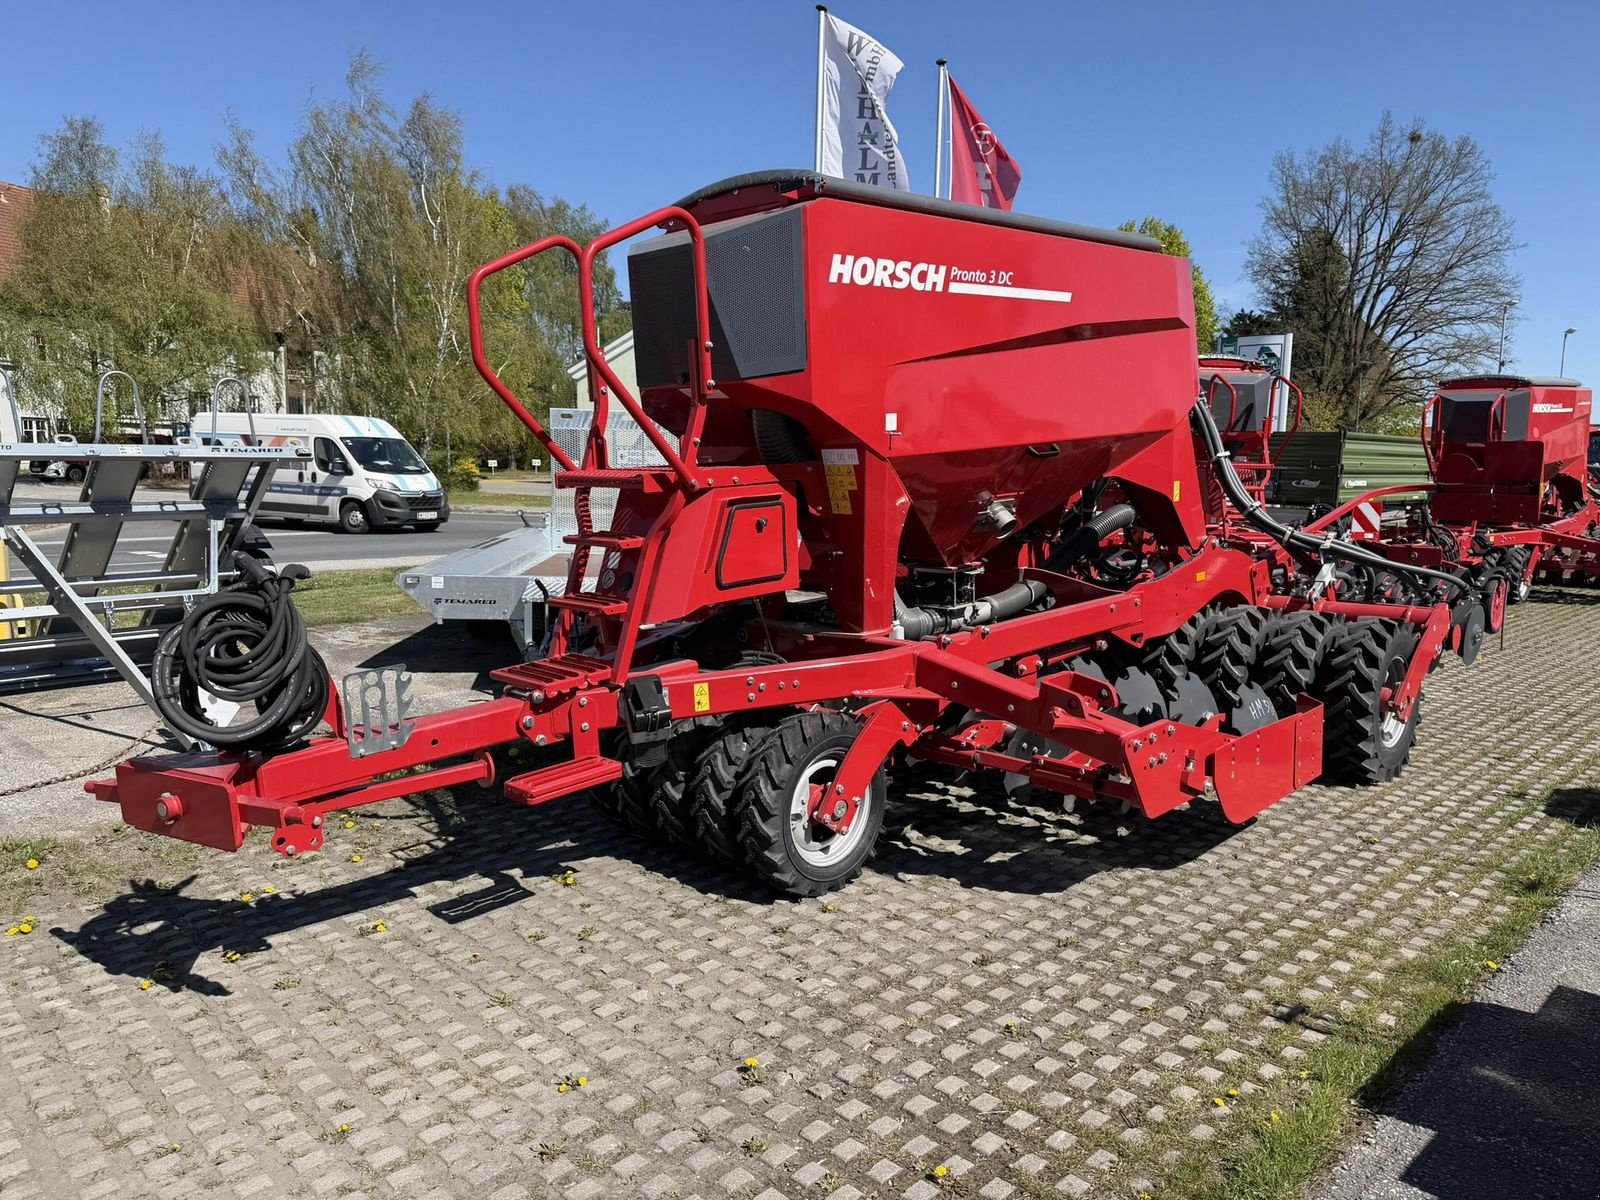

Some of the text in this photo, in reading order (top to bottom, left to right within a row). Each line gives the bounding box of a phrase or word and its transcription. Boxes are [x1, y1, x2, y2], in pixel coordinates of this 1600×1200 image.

[864, 44, 886, 86] mbH
[847, 30, 881, 186] WHALM
[829, 254, 1013, 292] HORSCH Pronto 3 DC
